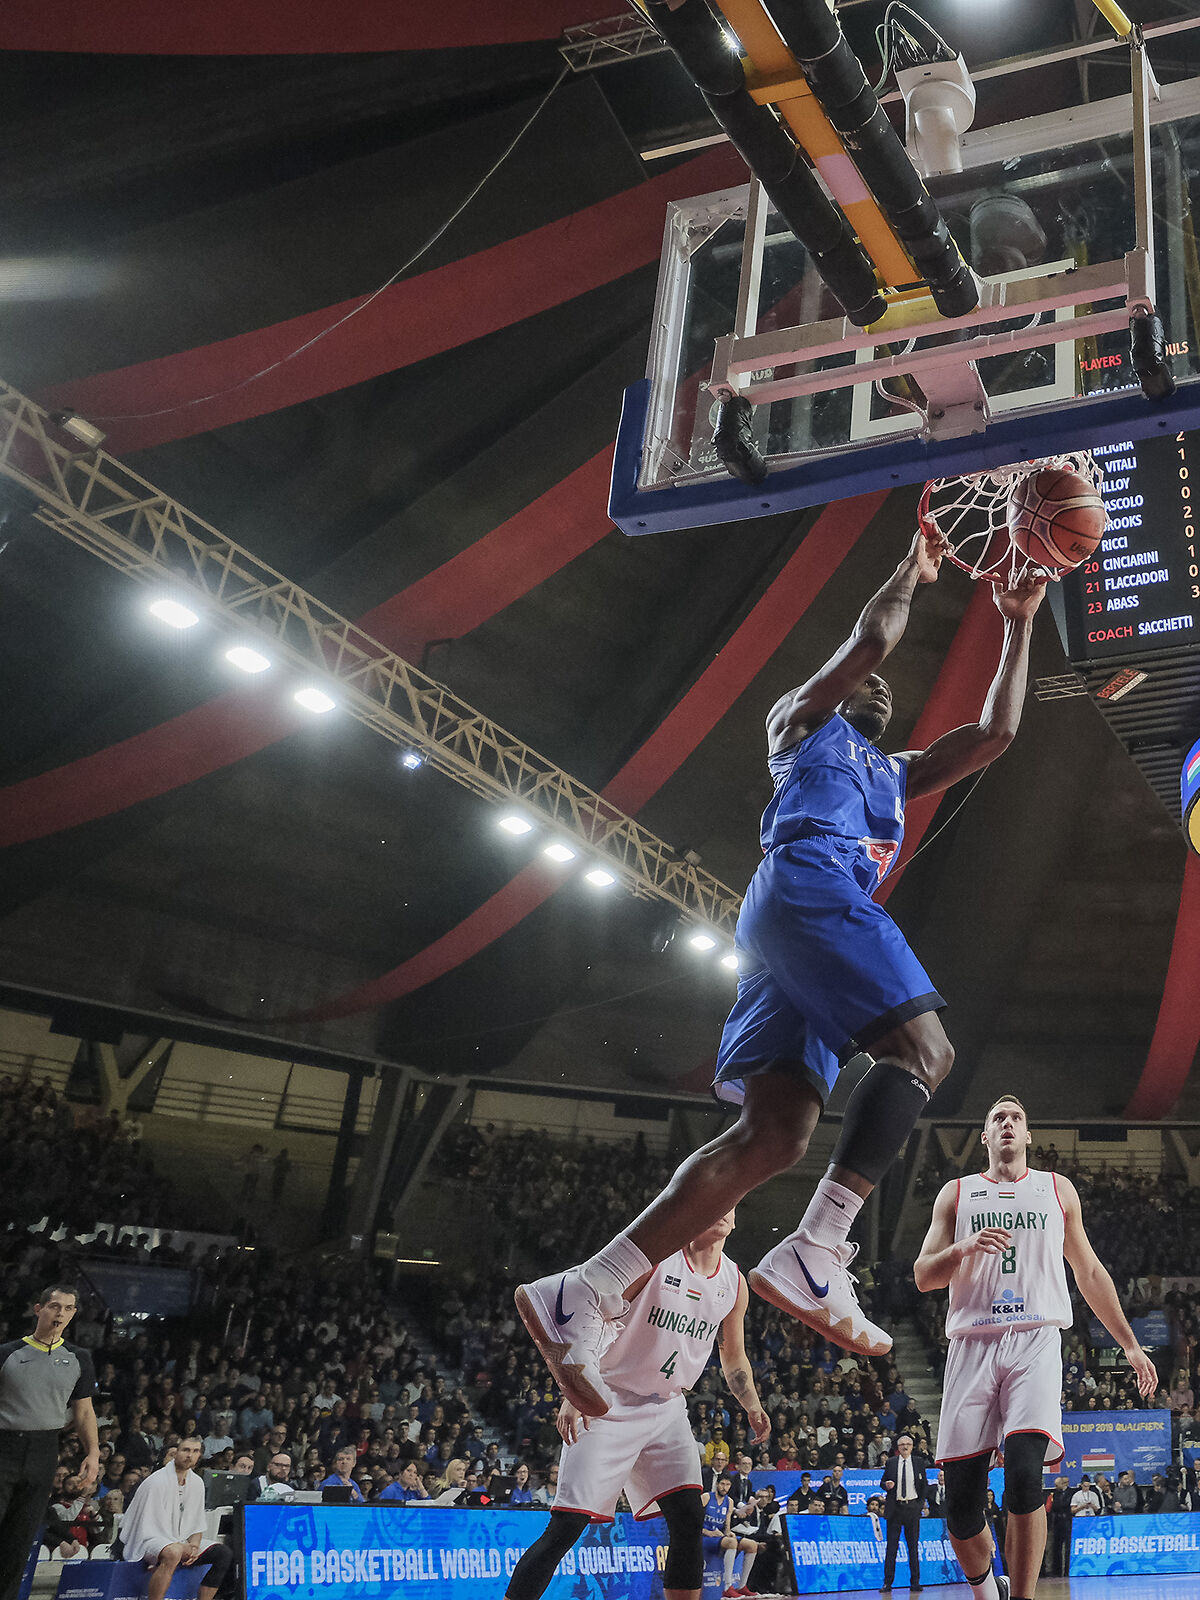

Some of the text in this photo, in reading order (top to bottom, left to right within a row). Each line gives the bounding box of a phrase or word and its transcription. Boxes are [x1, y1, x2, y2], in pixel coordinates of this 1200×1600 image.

[1079, 354, 1123, 372] PLAYERS
[1104, 456, 1138, 474] VITALI
[1178, 448, 1184, 459] 1
[1178, 466, 1189, 480] 0
[1180, 486, 1191, 499] 0
[1182, 505, 1193, 519] 2
[1101, 536, 1128, 552] RICCI
[1184, 524, 1195, 538] 0
[1084, 561, 1100, 574] 20
[1102, 550, 1159, 572] CINCIARINI
[1188, 545, 1194, 557] 1
[1085, 582, 1100, 594] 21
[1104, 568, 1169, 591] FLACCADORI
[1188, 564, 1199, 578] 0
[1087, 602, 1103, 615] 23
[1106, 594, 1140, 612] ABASS
[1190, 584, 1200, 599] 3
[1087, 614, 1193, 643] COACH SACCHETTI
[970, 1211, 1048, 1234] HUNGARY
[1001, 1245, 1017, 1275] 8
[991, 1303, 1025, 1315] K&H
[647, 1305, 718, 1342] HUNGARY
[659, 1350, 679, 1380] 4
[793, 1540, 820, 1566] FIBA
[821, 1540, 878, 1566] BASKETBALL
[1074, 1537, 1108, 1556] FIBA
[1109, 1534, 1200, 1554] BASKETBALL
[251, 1549, 305, 1587] FIBA
[311, 1547, 439, 1585] BASKETBALL
[441, 1547, 501, 1580] WORLD
[579, 1545, 656, 1576] QUALIFIERS
